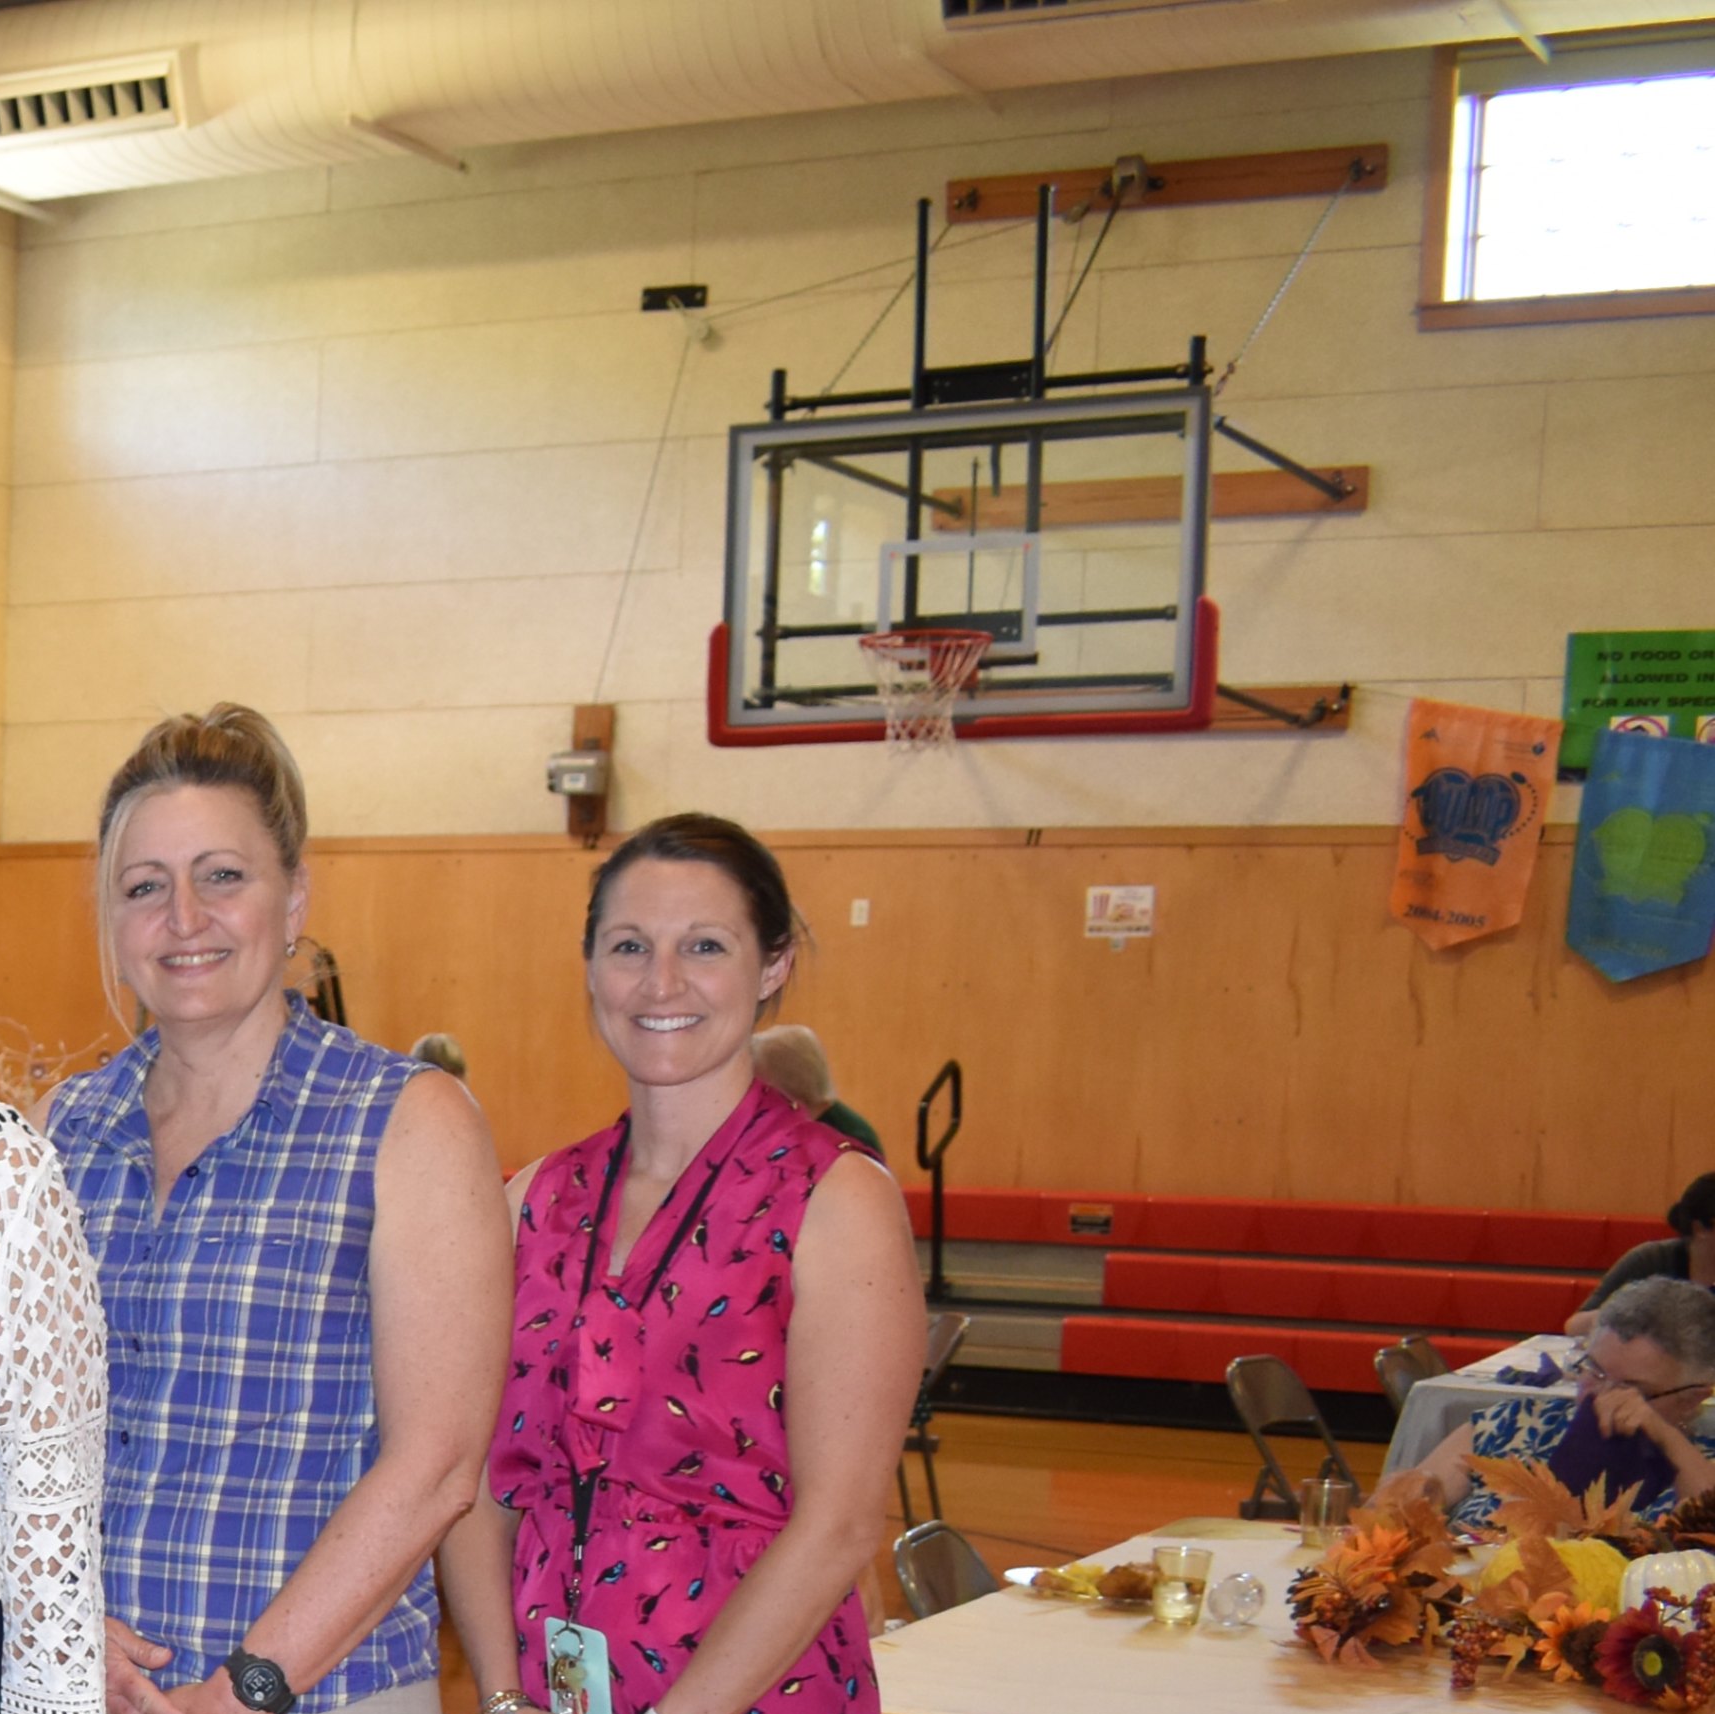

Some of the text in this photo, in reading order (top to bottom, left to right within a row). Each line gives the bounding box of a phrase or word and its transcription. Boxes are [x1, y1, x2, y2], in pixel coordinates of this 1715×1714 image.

[1597, 652, 1623, 661] NO
[1630, 651, 1681, 661] FOOD
[1600, 673, 1689, 684] ALLOWED
[1582, 698, 1618, 708] FOR
[1625, 698, 1660, 707] ANY
